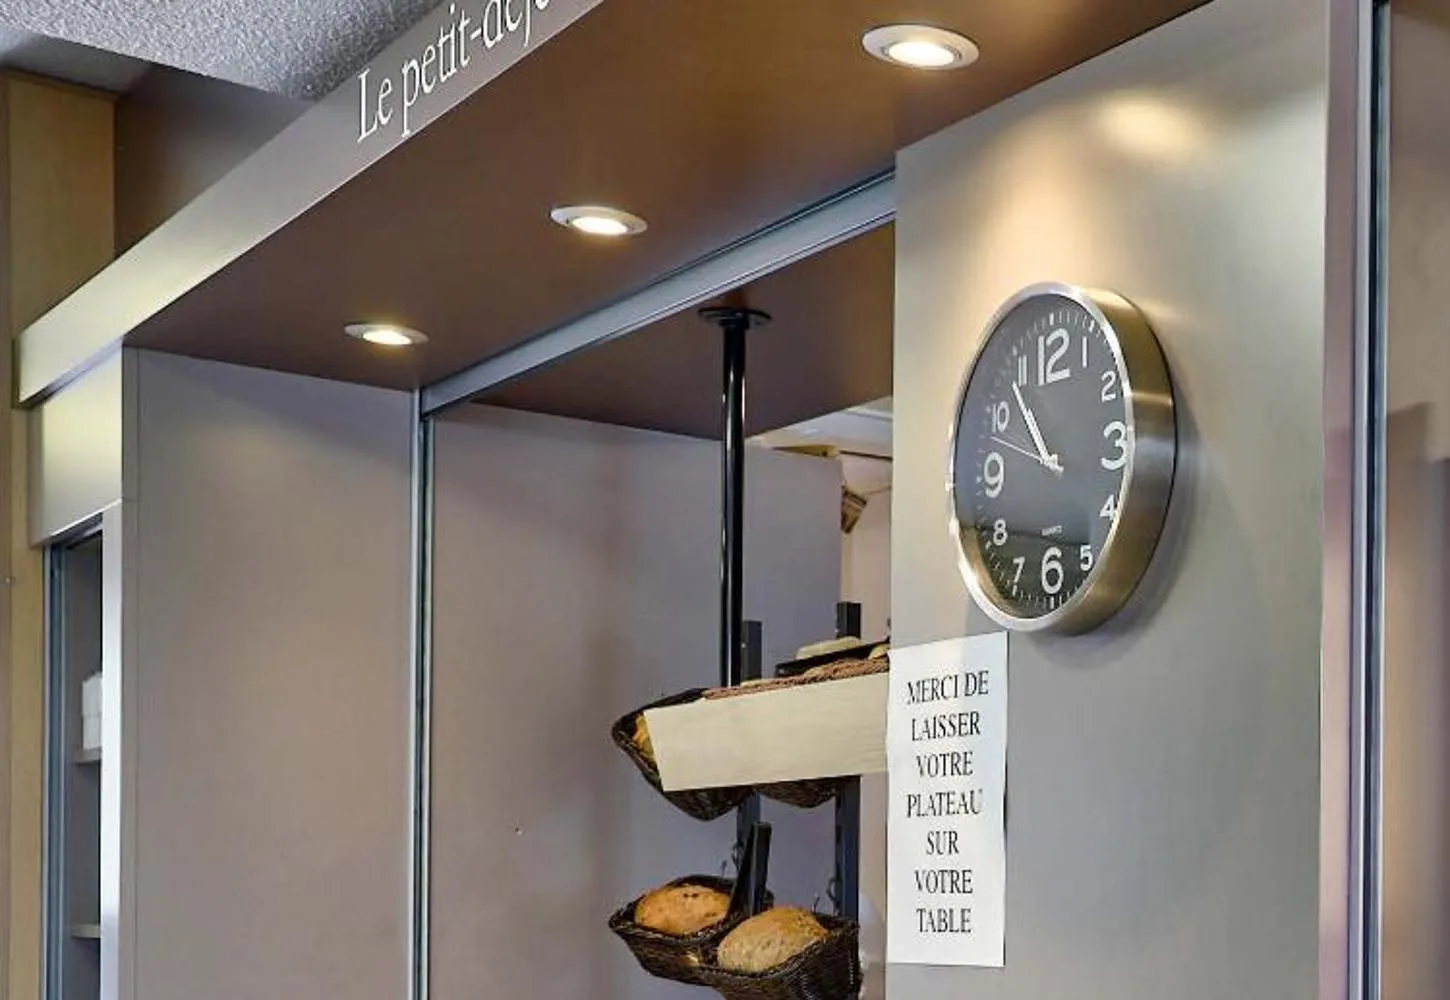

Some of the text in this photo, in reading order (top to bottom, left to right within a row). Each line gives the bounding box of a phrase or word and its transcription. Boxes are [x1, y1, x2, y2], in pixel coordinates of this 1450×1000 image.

[357, 68, 393, 143] Le
[1037, 328, 1071, 386] 12
[1082, 336, 1088, 368] 1
[1018, 354, 1028, 387] 11
[1100, 371, 1116, 401] 2
[991, 401, 1010, 434] 10
[1101, 421, 1128, 470] 3
[984, 451, 1005, 499] 9
[1100, 494, 1118, 520] 4
[994, 519, 1009, 546] 8
[1013, 556, 1025, 583] 7
[1041, 547, 1064, 594] 6
[1080, 545, 1093, 572] 5
[907, 670, 989, 706] MERCI DE
[911, 710, 981, 742] LAISSER
[916, 751, 973, 778] VOTRE
[907, 789, 983, 818] PLATEAU
[926, 830, 960, 855] SUR
[914, 869, 973, 895] VOTRE
[916, 908, 972, 934] TABLE
